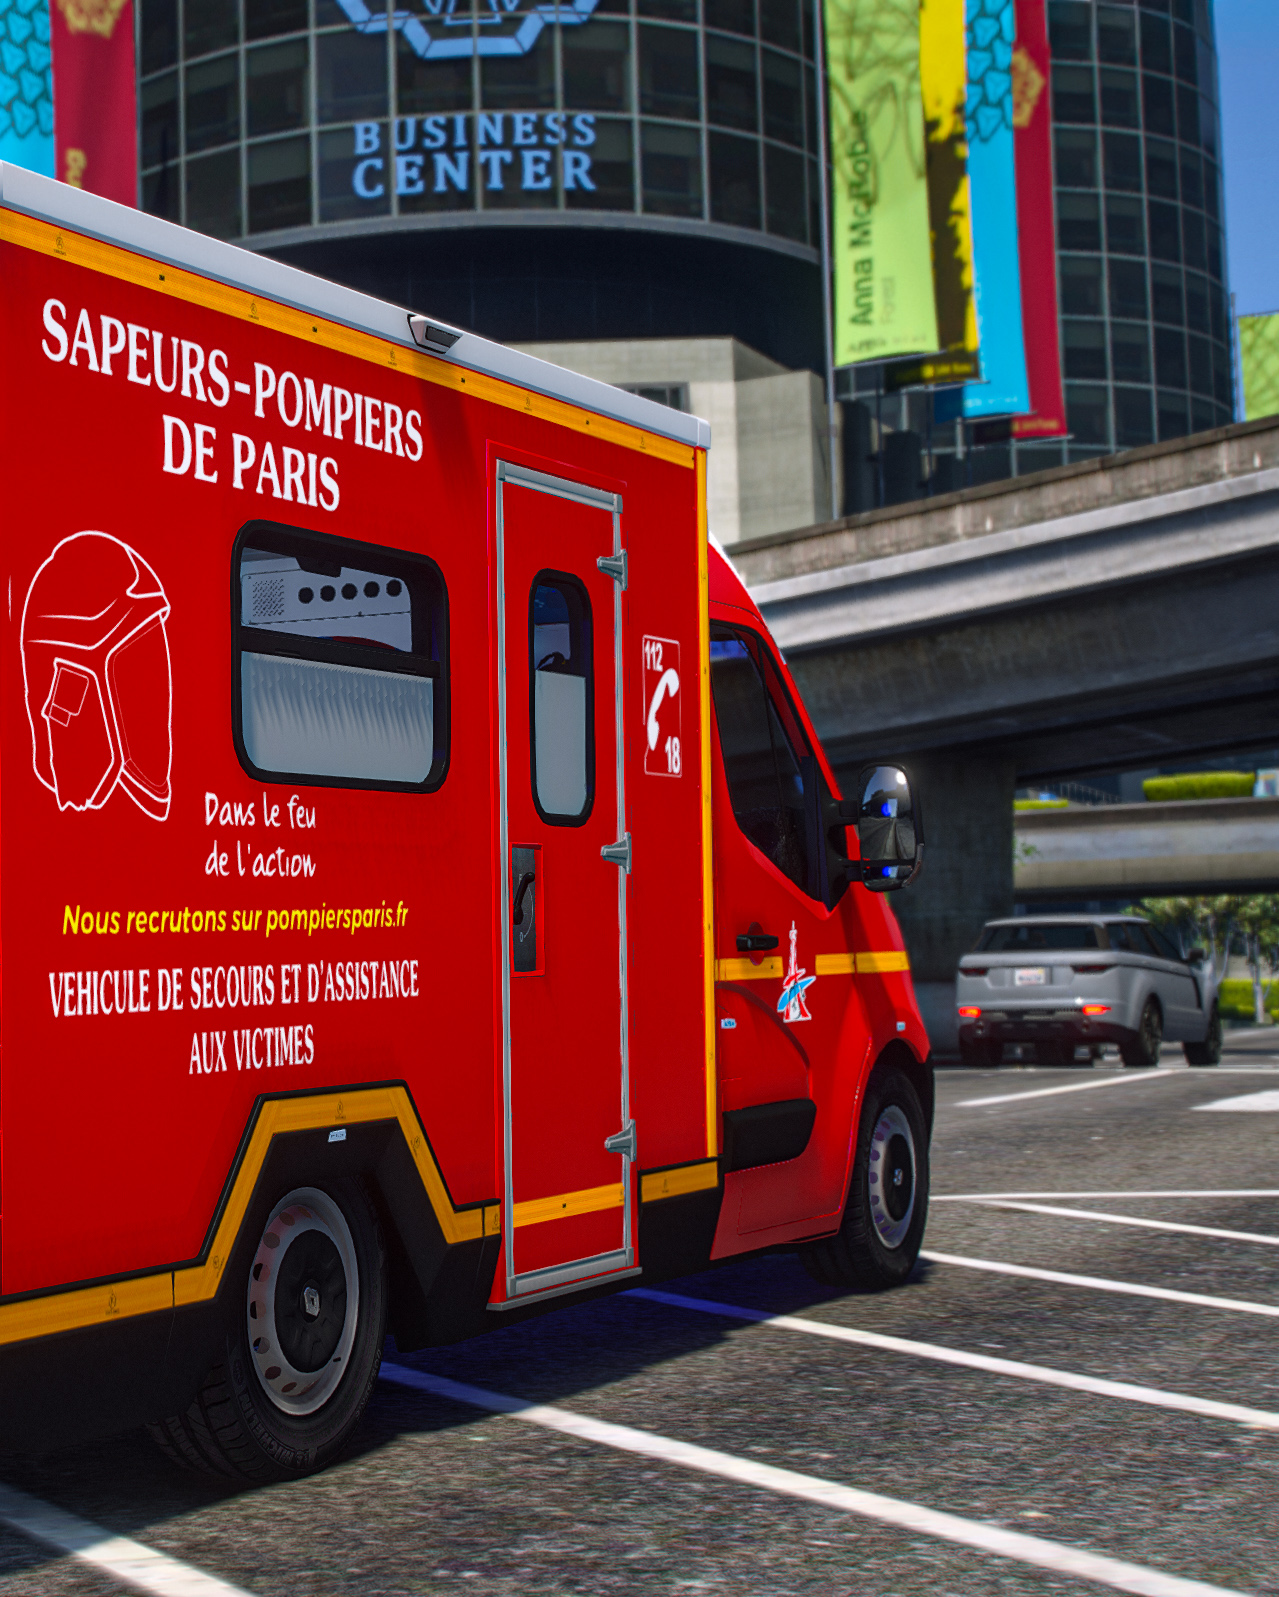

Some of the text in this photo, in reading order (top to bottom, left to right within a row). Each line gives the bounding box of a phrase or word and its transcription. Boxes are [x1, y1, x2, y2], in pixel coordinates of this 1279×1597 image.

[353, 113, 596, 155] BUSINESS
[352, 150, 597, 198] CENTER
[849, 257, 873, 327] Anna
[41, 298, 423, 462] SAPEURS-POMPIERS
[162, 414, 340, 512] DE PARIS
[644, 640, 664, 672] 112
[664, 735, 681, 775] 18
[204, 791, 317, 830] Dans le feu
[204, 839, 317, 878] de l'action
[62, 899, 410, 939] Nous recrutons sur pompiersparis.fr
[48, 959, 420, 1018] VEHICULE DE SECOURS ET D'ASSISTANCE
[188, 1023, 315, 1075] AUX VICTIMES
